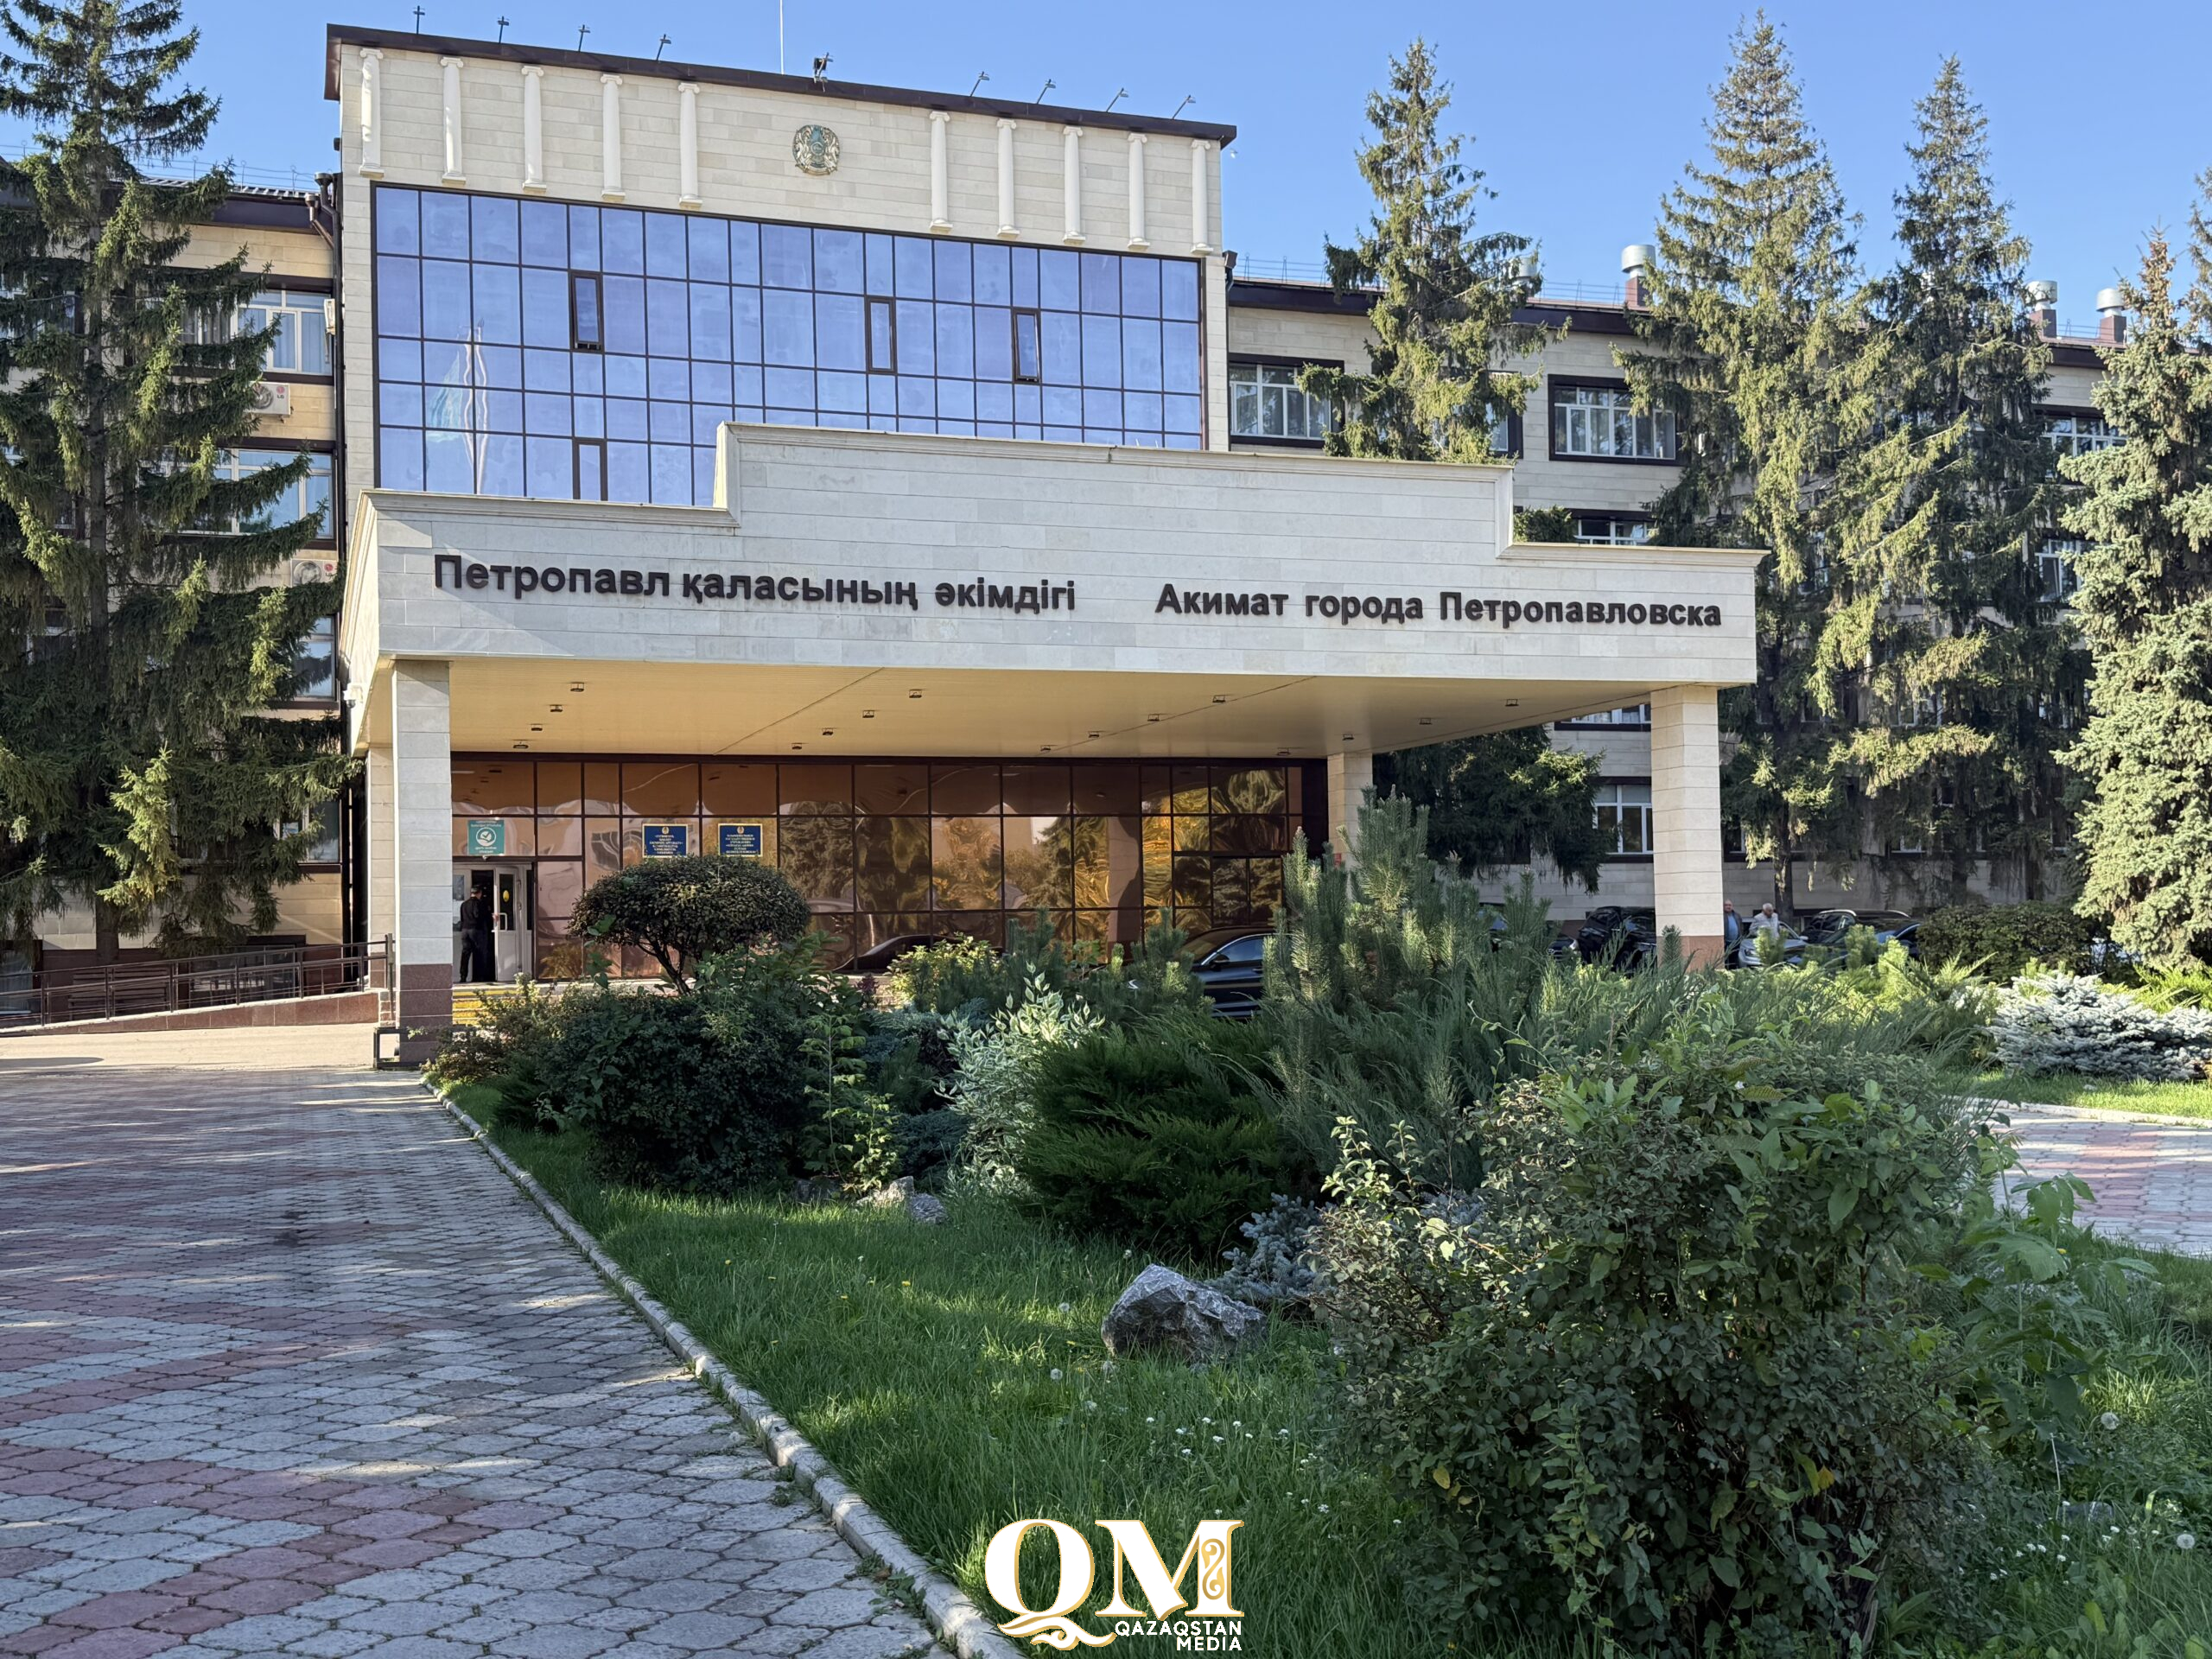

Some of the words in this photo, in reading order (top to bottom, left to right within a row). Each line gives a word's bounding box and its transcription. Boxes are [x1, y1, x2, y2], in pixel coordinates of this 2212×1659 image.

[434, 554, 671, 600] Петропавл
[681, 573, 918, 612] қаласының
[934, 576, 1076, 615] әкімдігі
[1154, 583, 1290, 617] Акимат
[1305, 594, 1424, 626] города
[1440, 591, 1723, 629] Петропавловска
